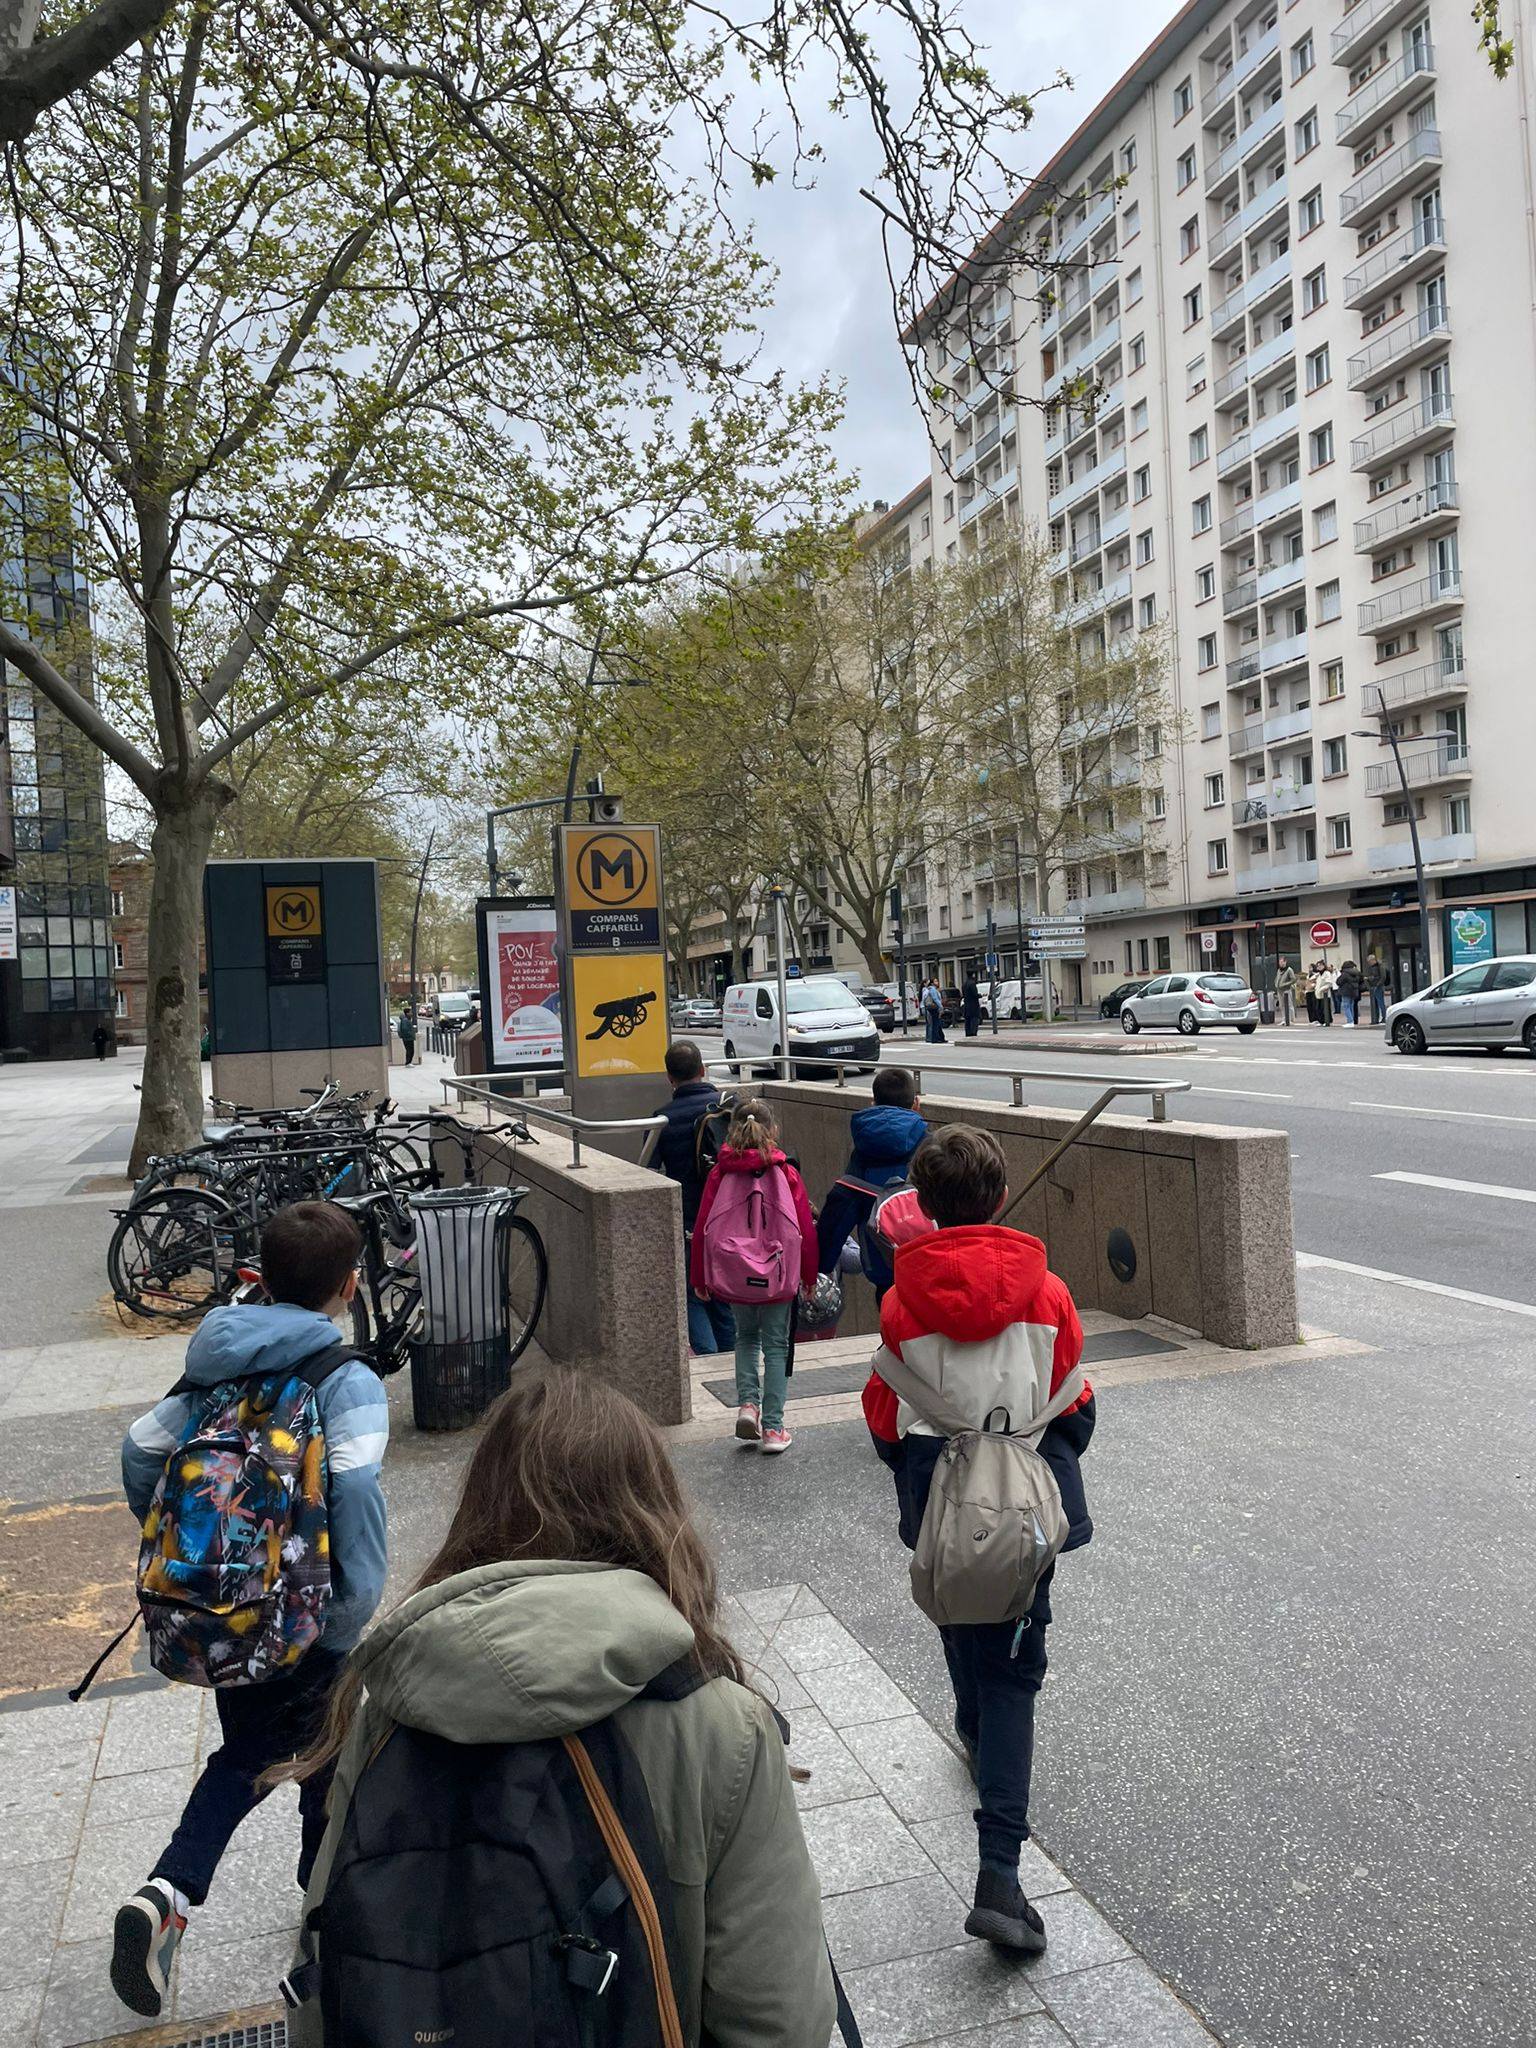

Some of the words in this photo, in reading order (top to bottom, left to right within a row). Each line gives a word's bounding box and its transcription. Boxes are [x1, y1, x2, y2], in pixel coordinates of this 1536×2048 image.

[590, 849, 634, 889] M
[281, 900, 307, 923] M
[590, 914, 639, 923] COMPANS
[586, 923, 644, 933] CAFFARELLI
[612, 937, 621, 947] B
[504, 942, 534, 961] POV
